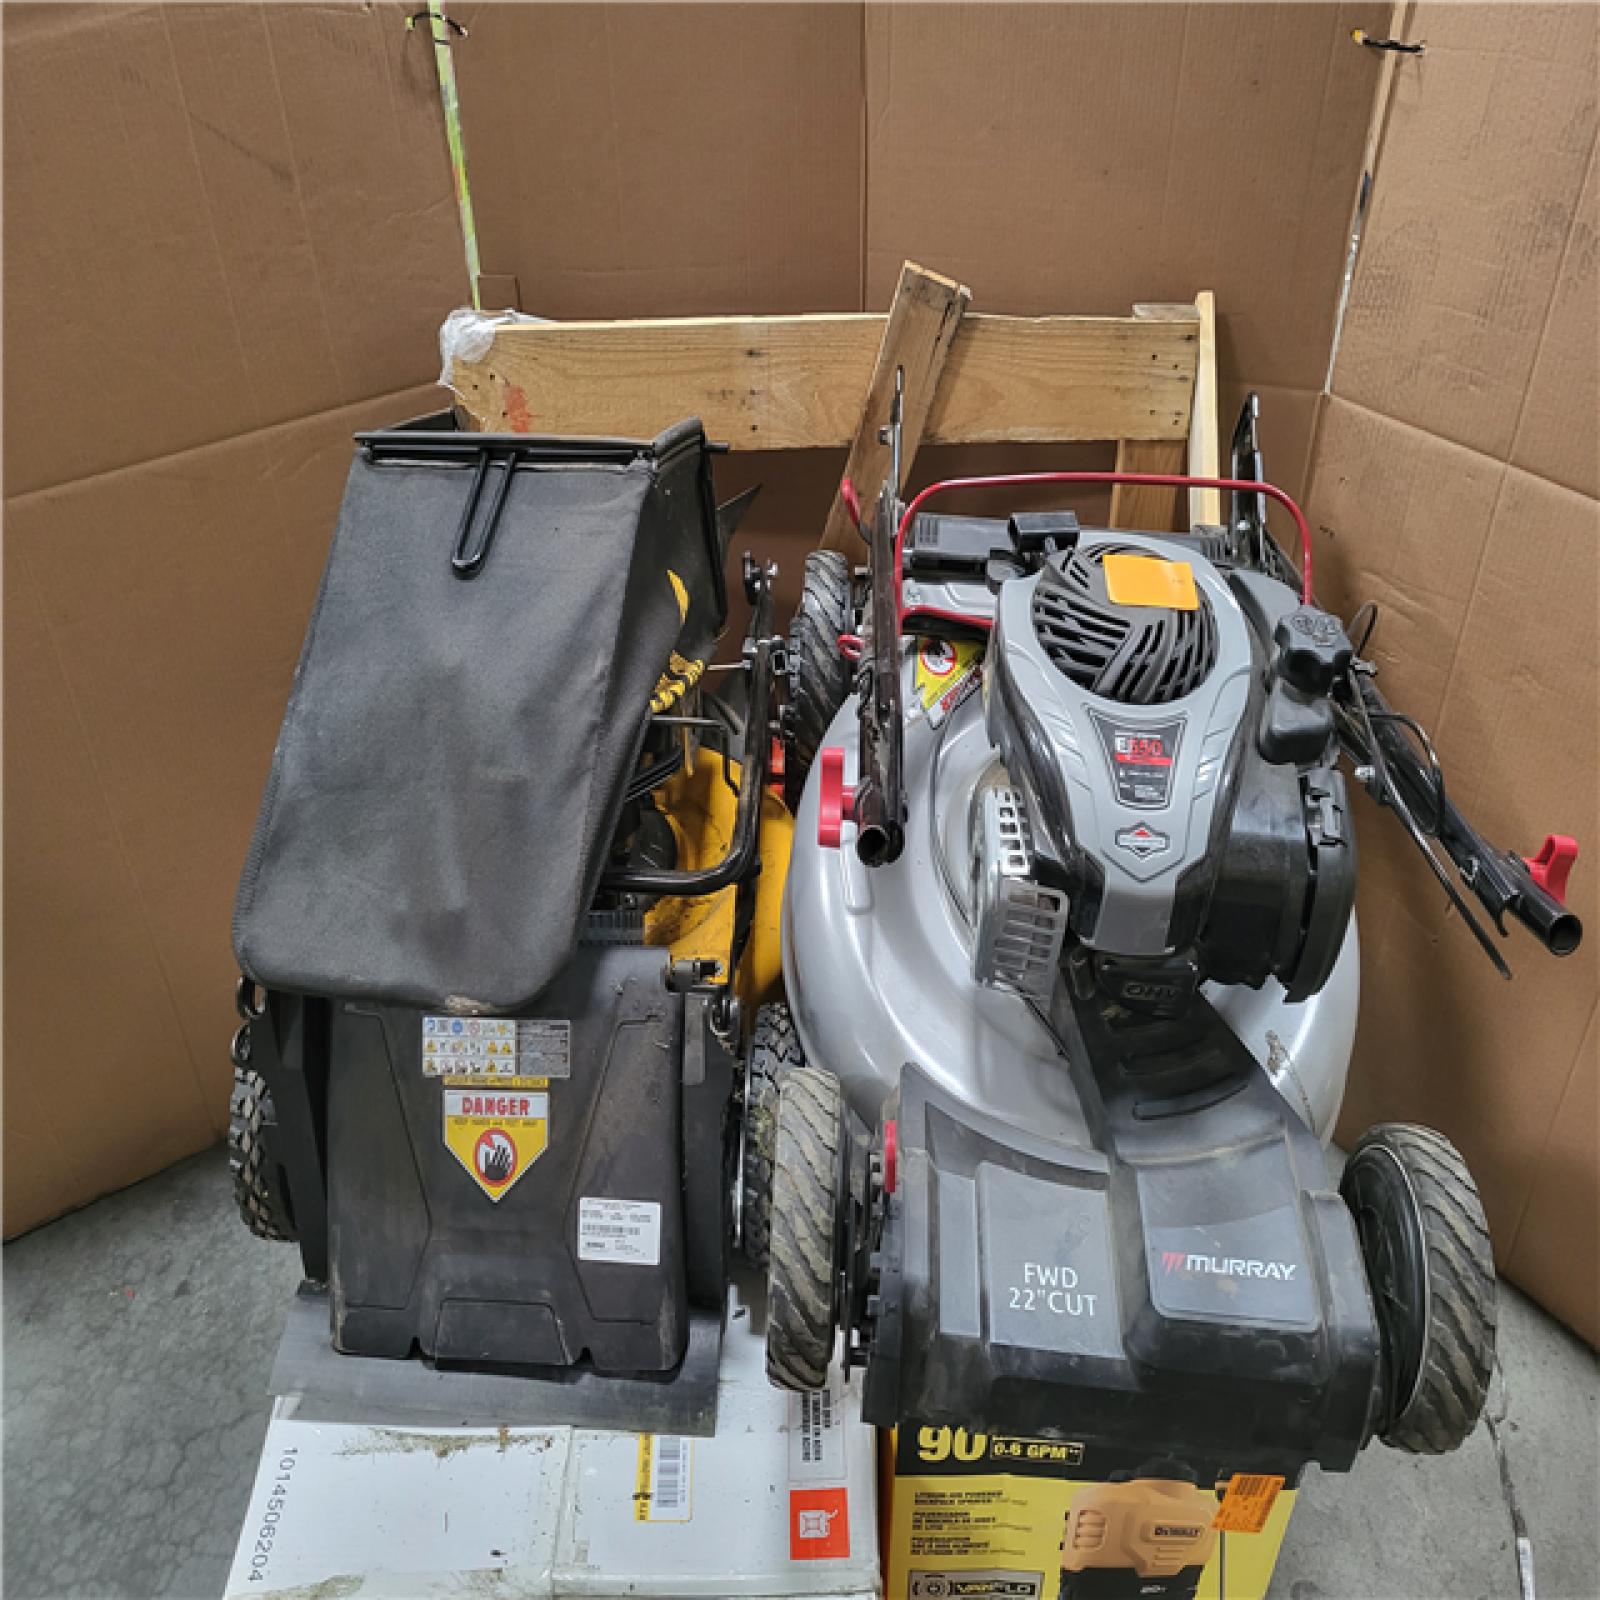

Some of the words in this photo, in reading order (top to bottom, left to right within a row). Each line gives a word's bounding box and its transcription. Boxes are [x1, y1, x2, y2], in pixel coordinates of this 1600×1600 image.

[462, 1097, 530, 1116] DANGER
[1024, 1262, 1078, 1288] FWD
[1187, 1254, 1297, 1280] MURRAY
[918, 1425, 987, 1461] 90
[248, 1447, 298, 1582] 1014506204
